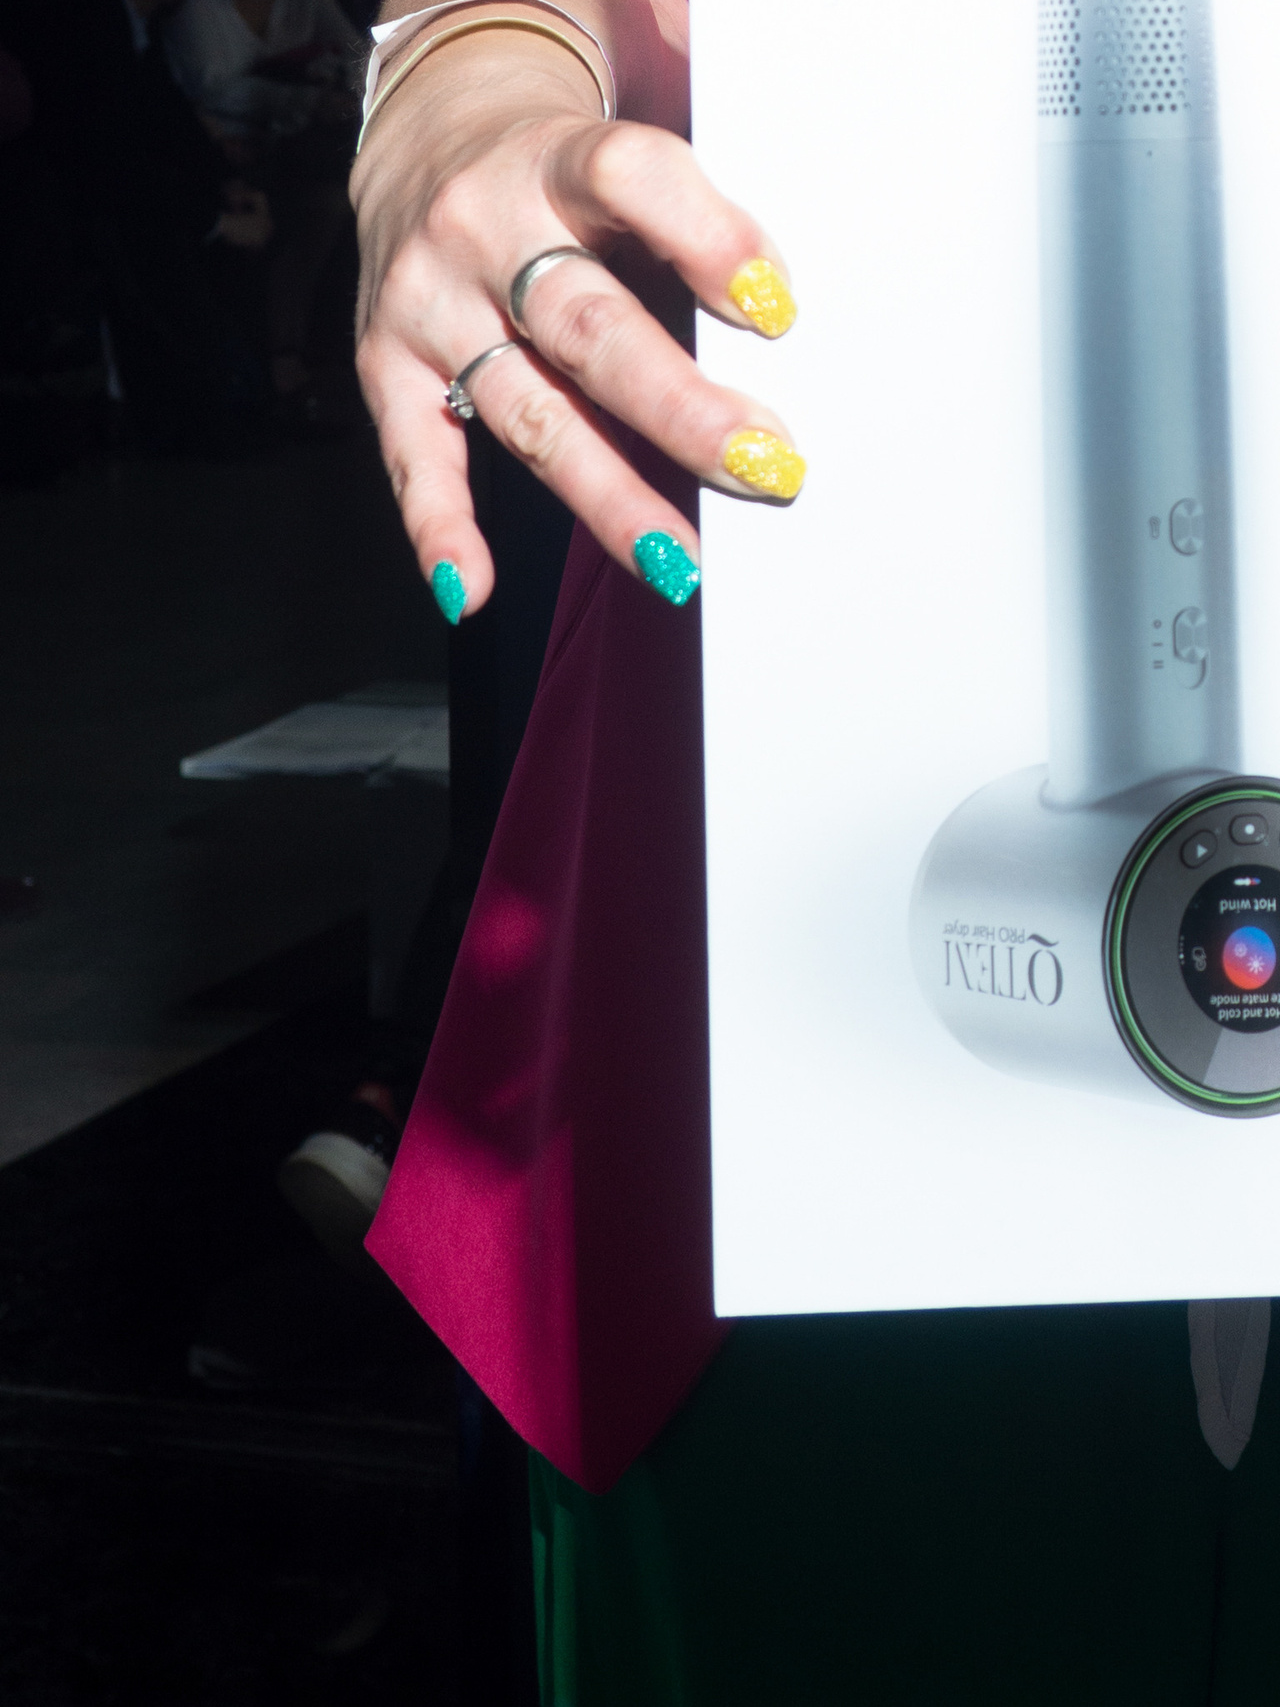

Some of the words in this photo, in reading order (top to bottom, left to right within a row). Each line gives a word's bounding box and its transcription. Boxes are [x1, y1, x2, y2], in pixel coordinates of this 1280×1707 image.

[1219, 898, 1251, 914] wind
[1254, 898, 1277, 912] Hot
[943, 919, 970, 938] dryer
[973, 924, 996, 941] Hair
[998, 926, 1025, 943] PRO
[944, 933, 1063, 1006] QTEM
[1210, 994, 1240, 1007] mode
[1242, 994, 1269, 1005] mate
[1218, 1008, 1241, 1021] cold
[1243, 1008, 1264, 1021] and
